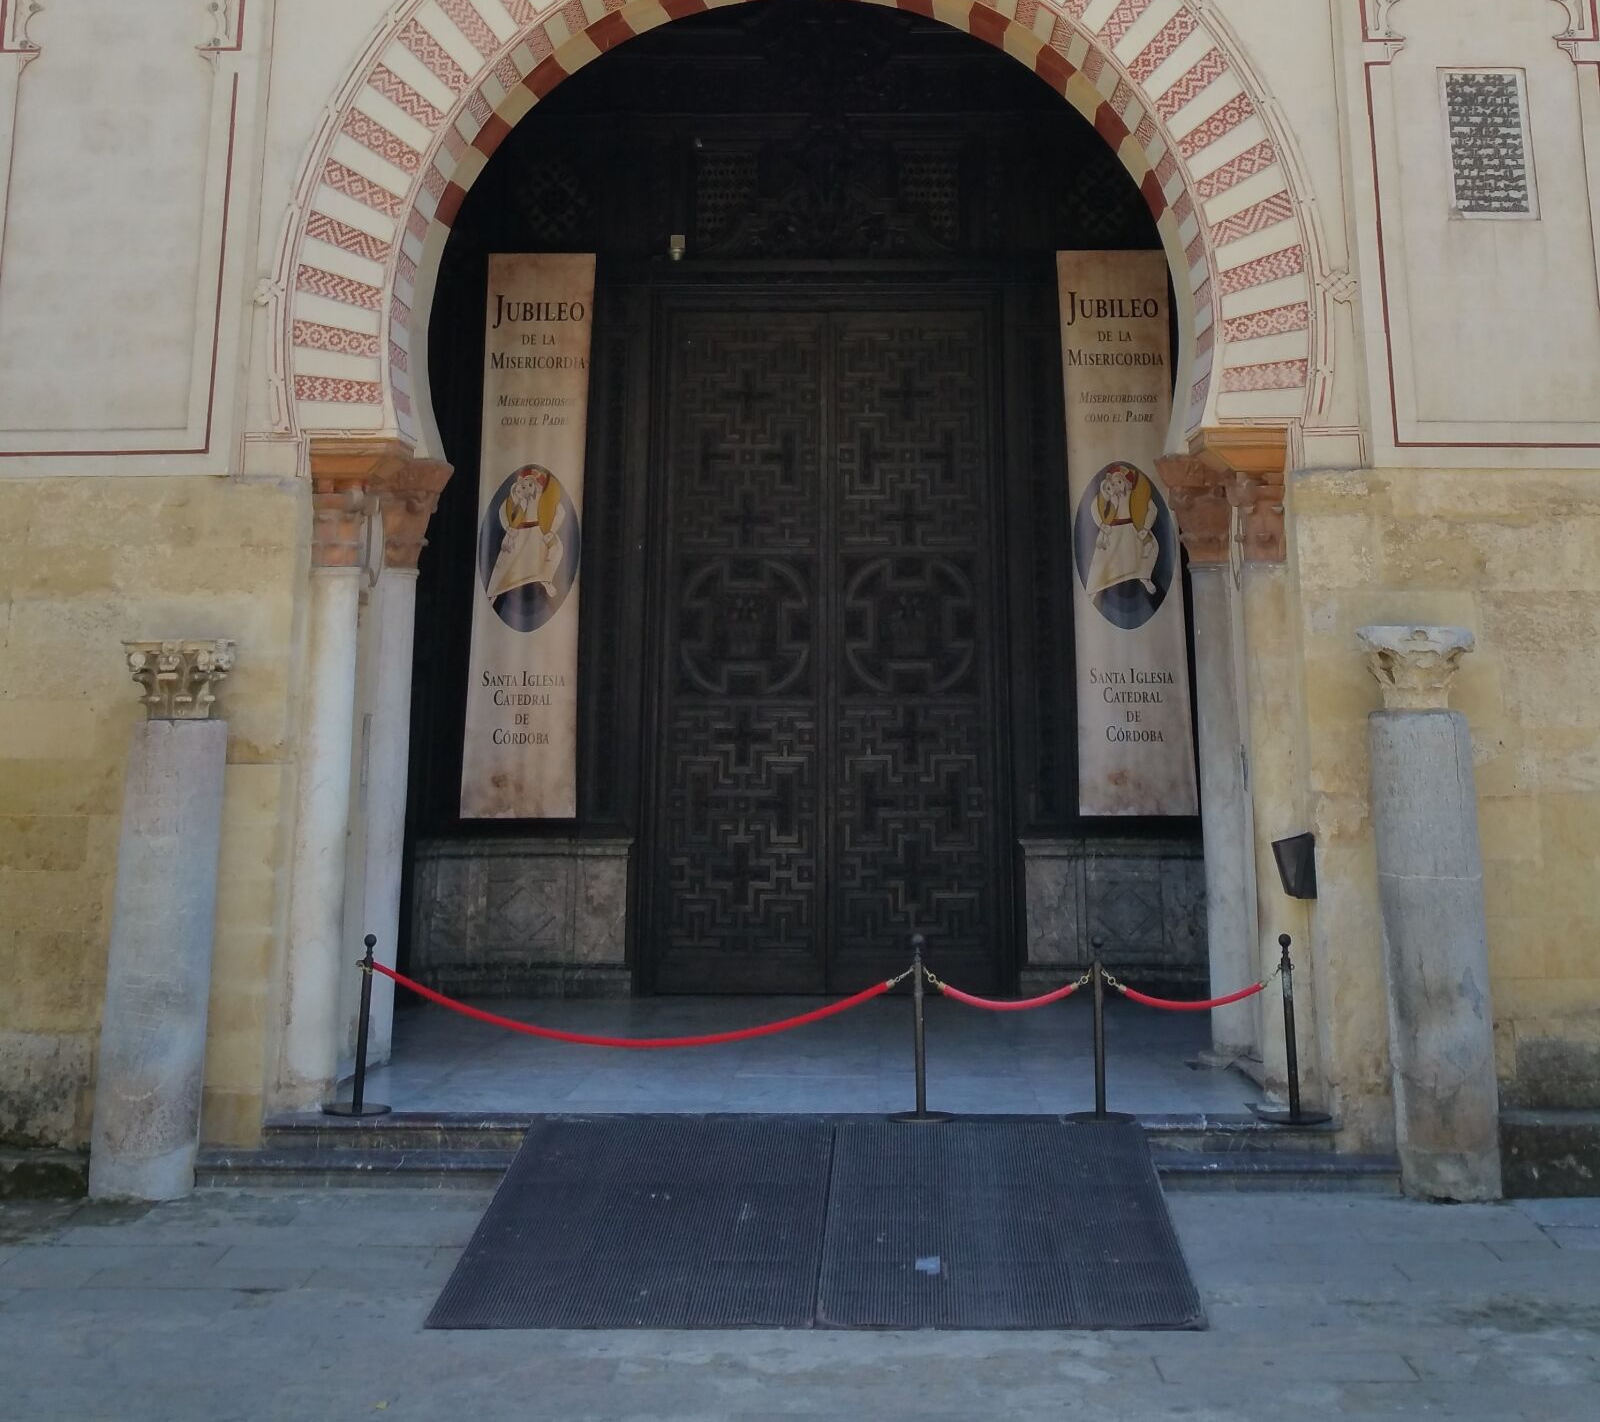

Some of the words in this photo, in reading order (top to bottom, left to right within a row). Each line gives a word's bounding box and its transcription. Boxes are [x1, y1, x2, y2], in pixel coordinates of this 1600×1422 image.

[492, 295, 585, 329] JUBILEO
[1067, 291, 1158, 326] JUBILEO
[522, 334, 536, 346] DE
[543, 334, 555, 345] LA
[1098, 331, 1112, 342] DE
[1119, 331, 1132, 342] LA
[491, 352, 585, 369] MISERICORDIA
[1068, 349, 1163, 366] MISERICORDIA
[1126, 411, 1154, 423] PADRE
[482, 671, 517, 686] SANTA
[522, 671, 565, 686] IGLESIA
[1090, 668, 1126, 683] SANTA
[1130, 668, 1174, 683] IGLESIA
[494, 690, 552, 705] CATEDRAL
[1103, 687, 1163, 703] CATEDRAL
[515, 714, 530, 725] DE
[1126, 711, 1141, 722] DE
